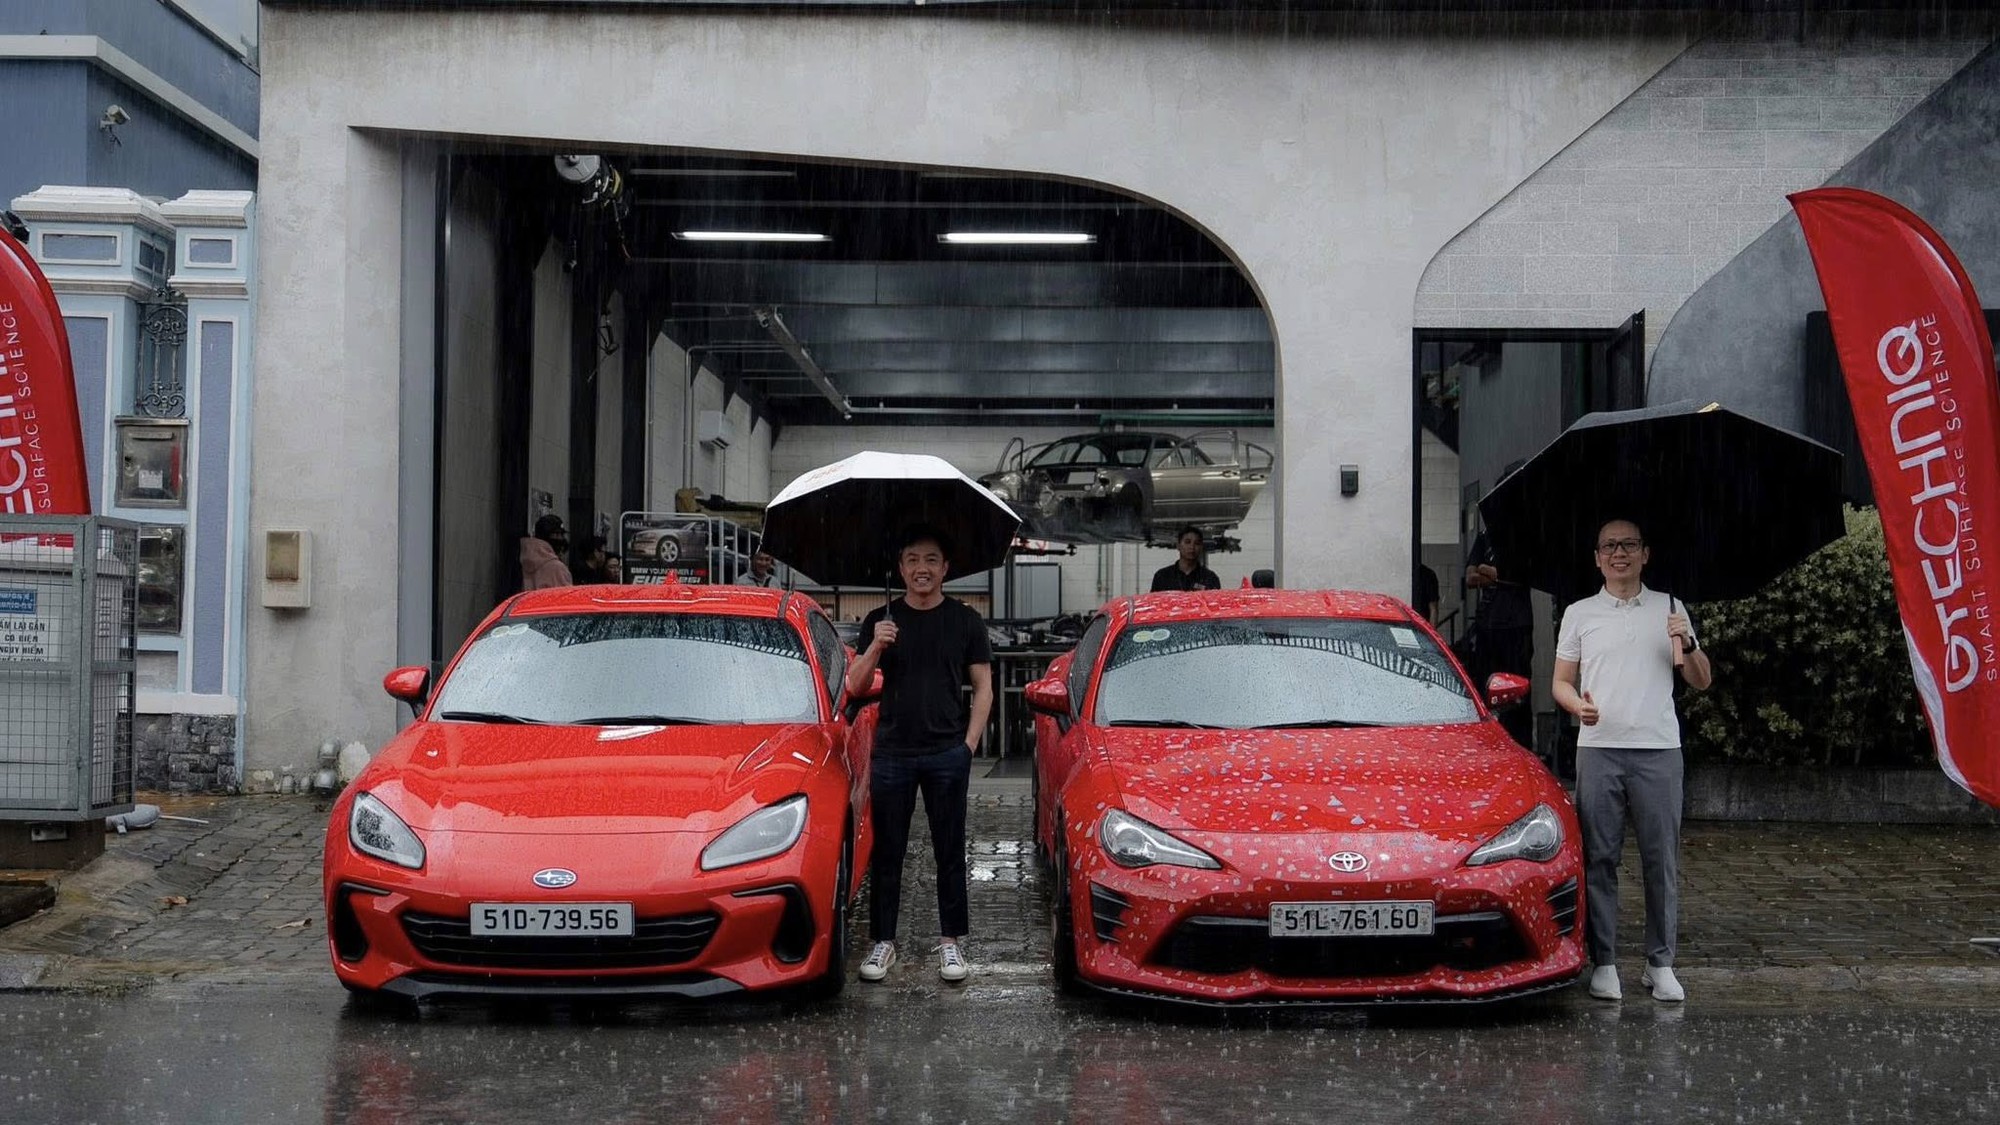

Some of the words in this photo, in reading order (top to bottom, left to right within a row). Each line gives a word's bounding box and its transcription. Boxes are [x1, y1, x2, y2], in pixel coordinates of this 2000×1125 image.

[0, 302, 31, 397] SCIENCE
[1921, 312, 1962, 431] SCIENCE
[23, 409, 51, 508] SURFACE
[1877, 319, 1979, 693] GTECHNIQ
[1953, 447, 1981, 570] SURFACE
[1971, 590, 1998, 681] SMART
[484, 909, 618, 930] 51D-739.56
[1284, 908, 1419, 930] 51L-761.60
